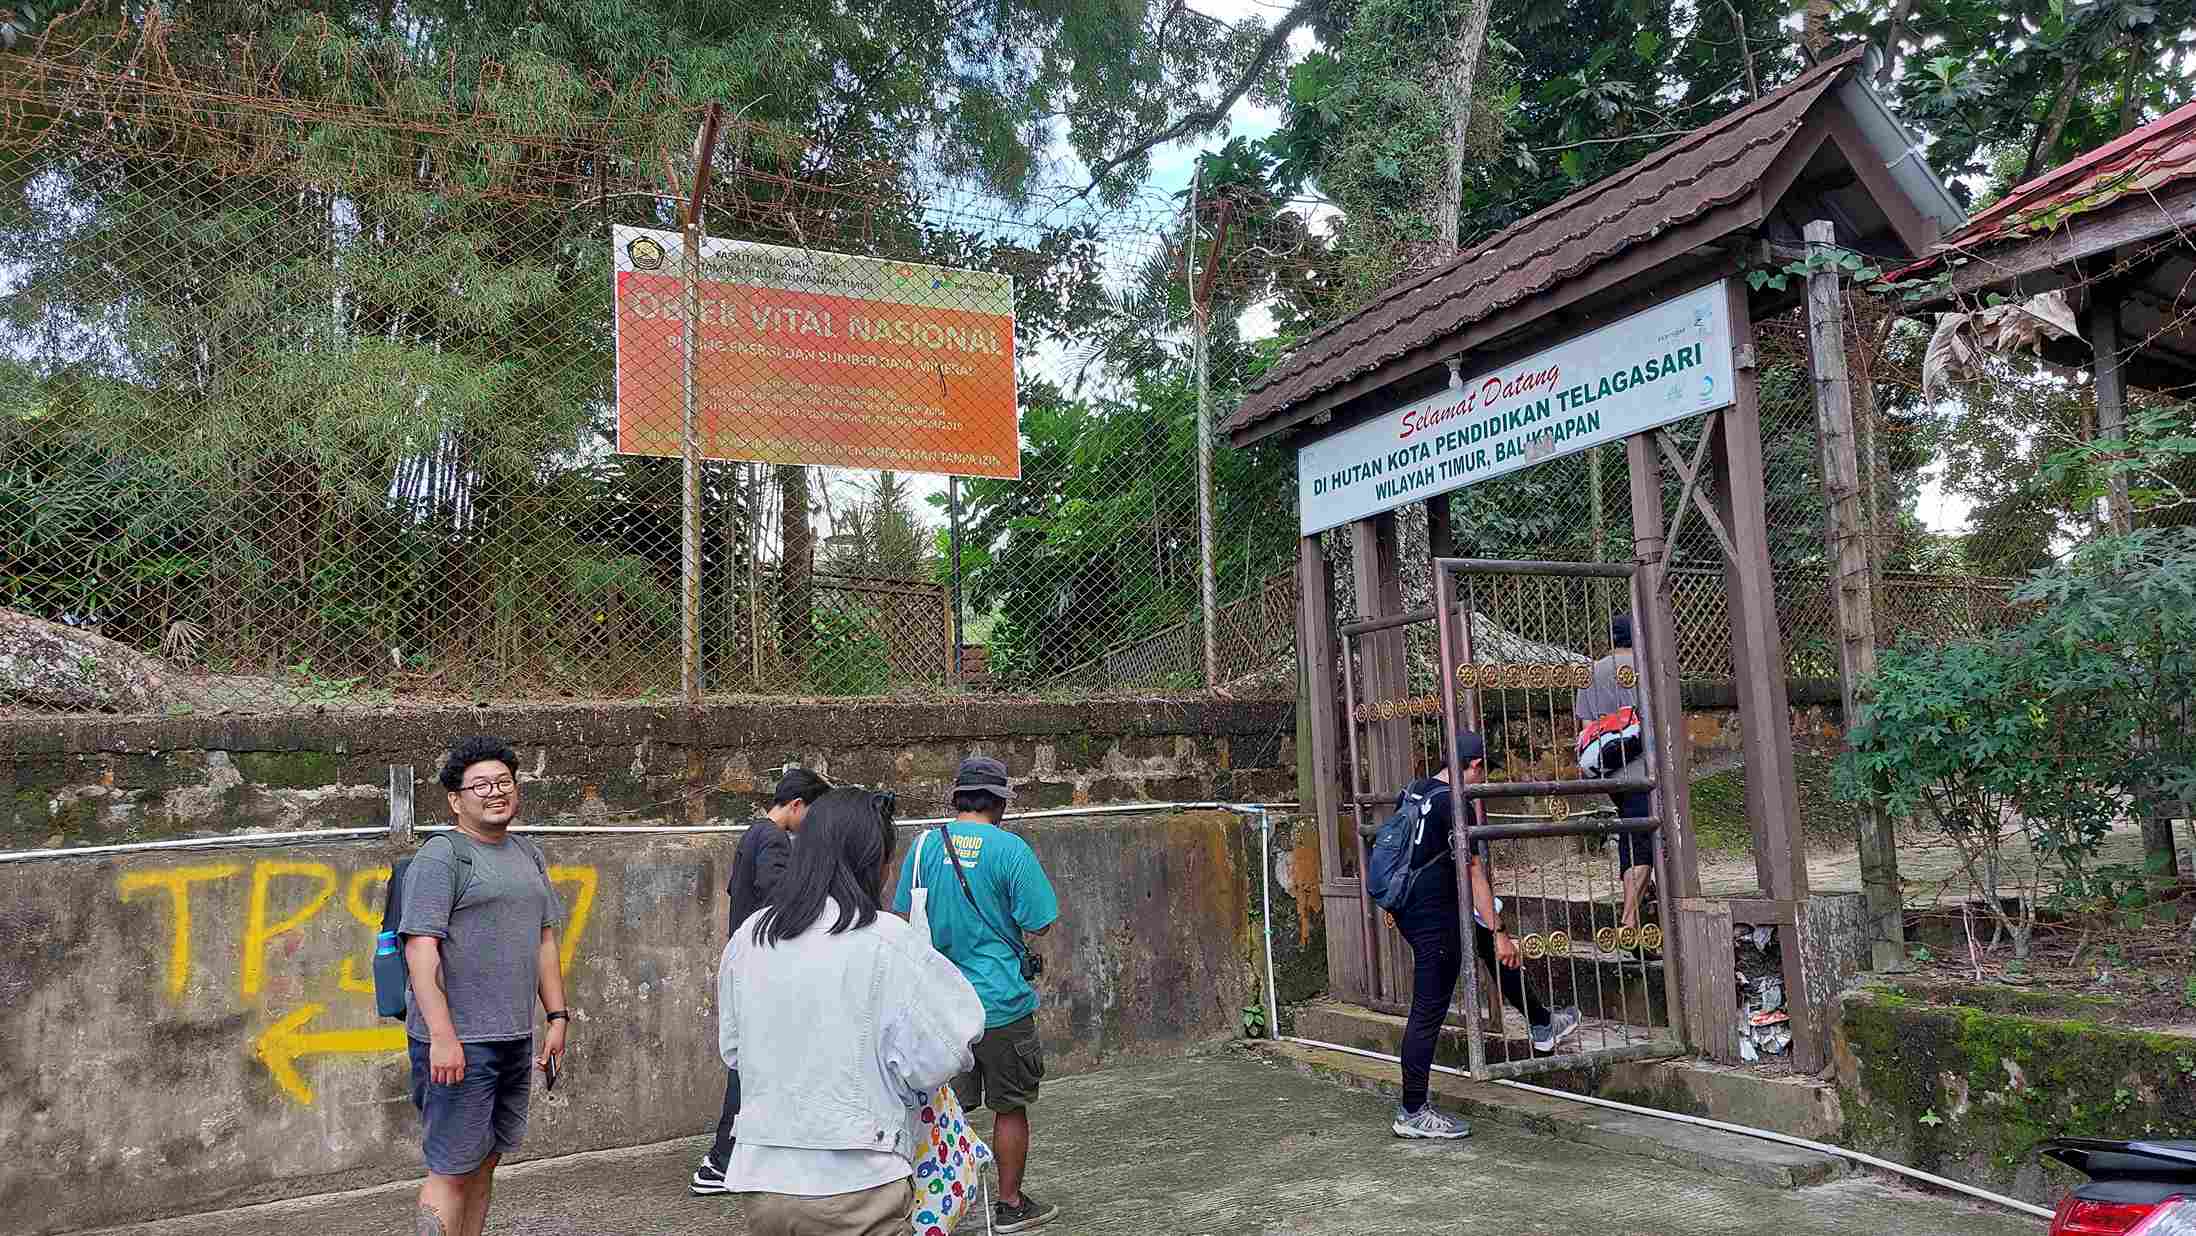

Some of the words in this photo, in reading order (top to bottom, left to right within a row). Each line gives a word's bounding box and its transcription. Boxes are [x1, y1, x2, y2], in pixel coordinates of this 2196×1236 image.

[630, 289, 738, 329] OBEK
[750, 303, 834, 338] VITAL
[847, 315, 1003, 356] NASIONAL
[667, 335, 726, 353] BING
[729, 342, 782, 359] ENERGI
[785, 347, 816, 362] DAN
[819, 350, 878, 368] SUMBER
[1313, 476, 1327, 496] DI
[1331, 458, 1383, 490] HUTAN
[1387, 441, 1431, 472] KOTA
[1435, 397, 1551, 456] PENDIDIKAN
[1556, 342, 1702, 412] TELAGASARI
[1399, 389, 1477, 439] Selamat
[1481, 363, 1560, 408] Datang
[1375, 464, 1435, 501] WILAYAH
[1438, 448, 1491, 481] TIMUR,
[951, 834, 983, 850] ROUD
[116, 859, 393, 1002] TPS
